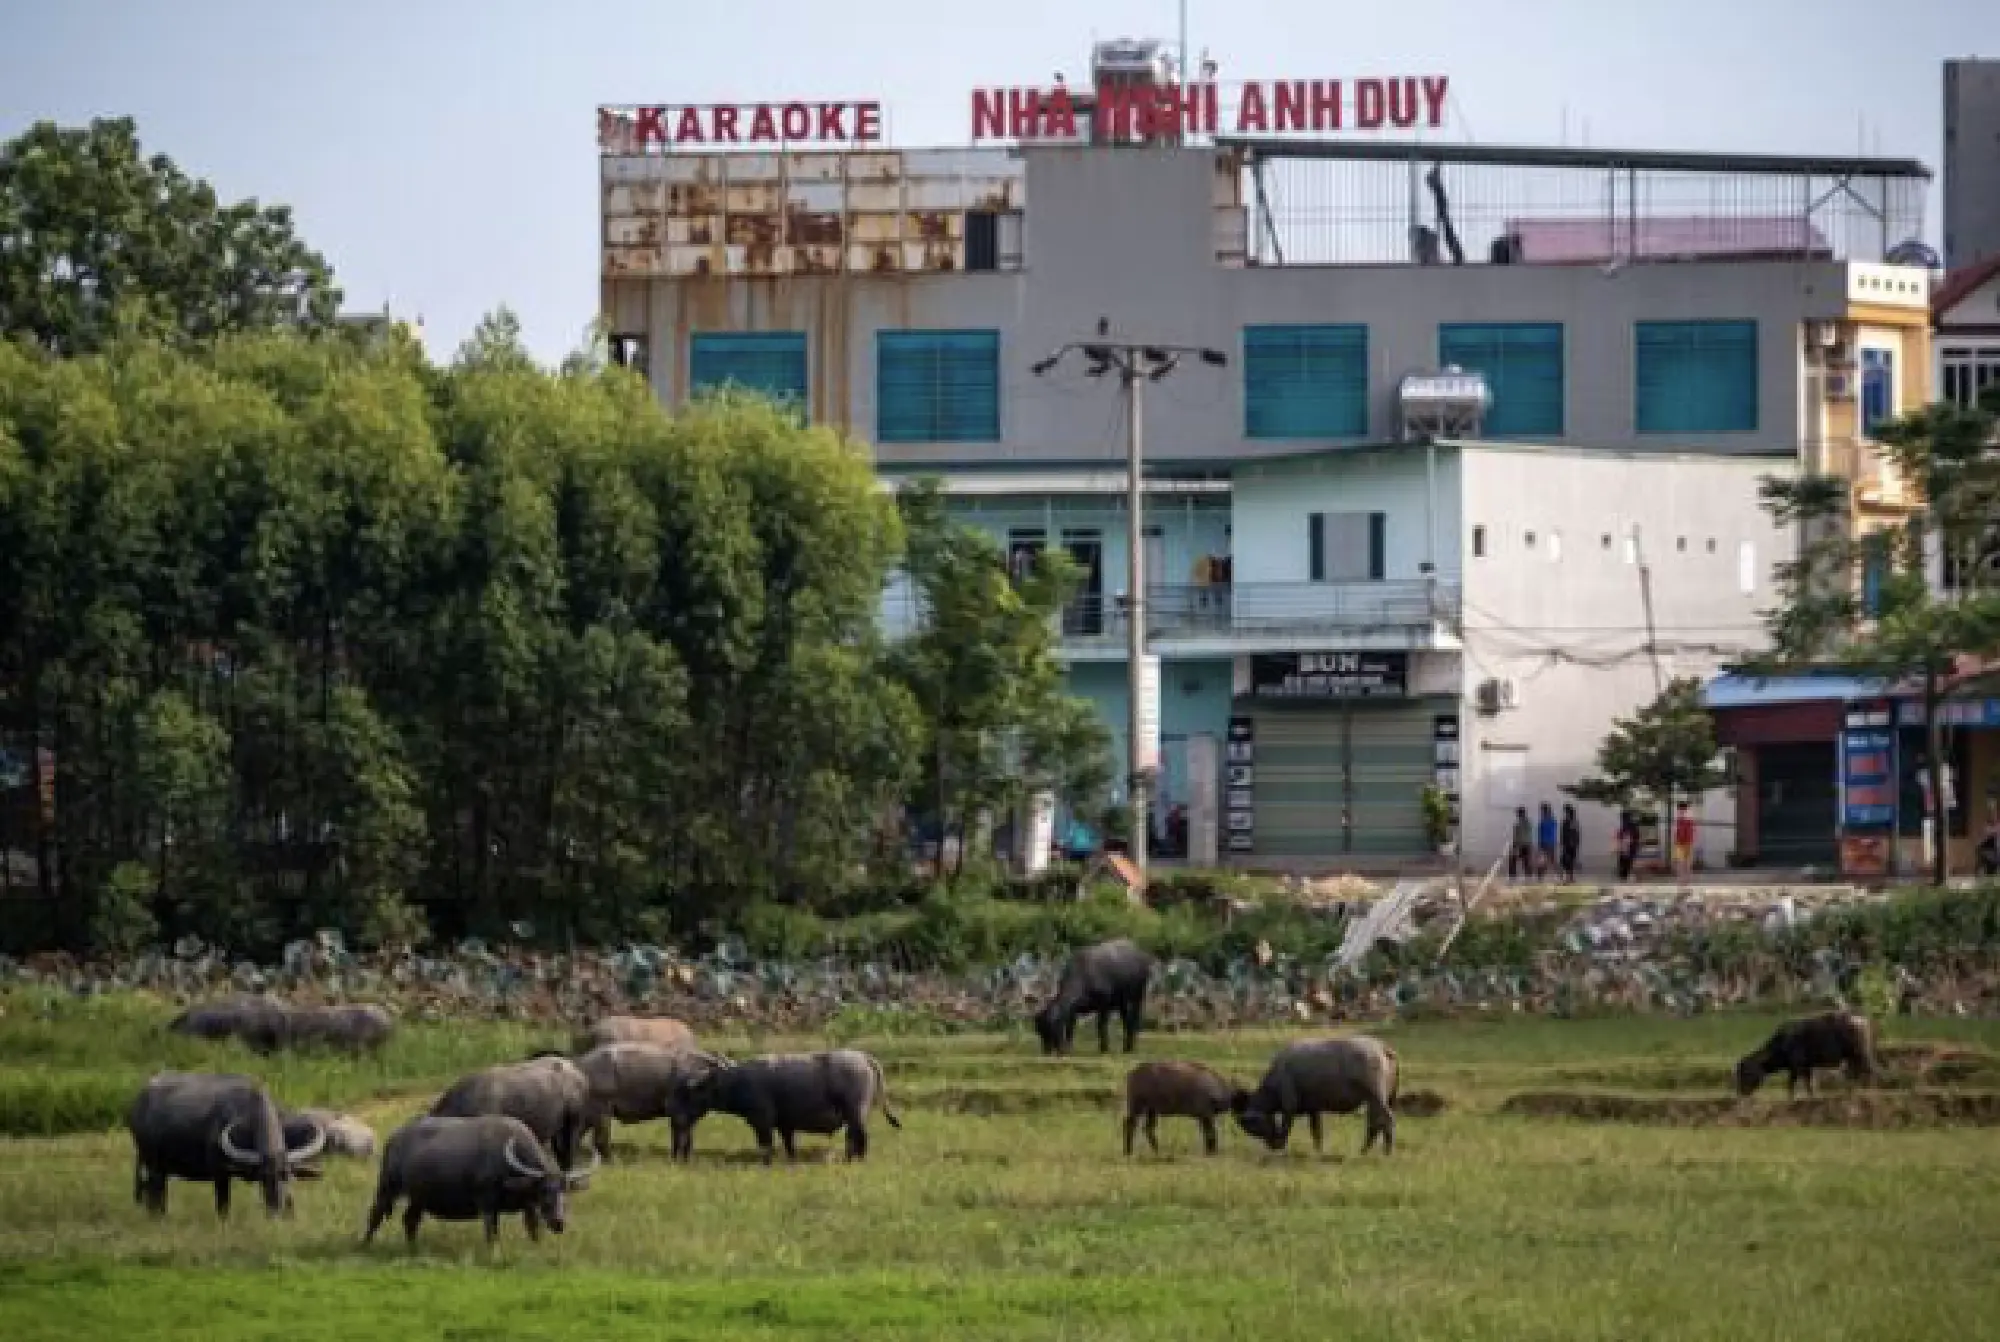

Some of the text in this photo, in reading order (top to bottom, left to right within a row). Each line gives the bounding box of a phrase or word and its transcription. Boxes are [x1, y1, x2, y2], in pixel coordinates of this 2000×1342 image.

[636, 102, 881, 142] KARAOKE
[1237, 80, 1342, 131] ANH
[1356, 76, 1449, 128] DUY
